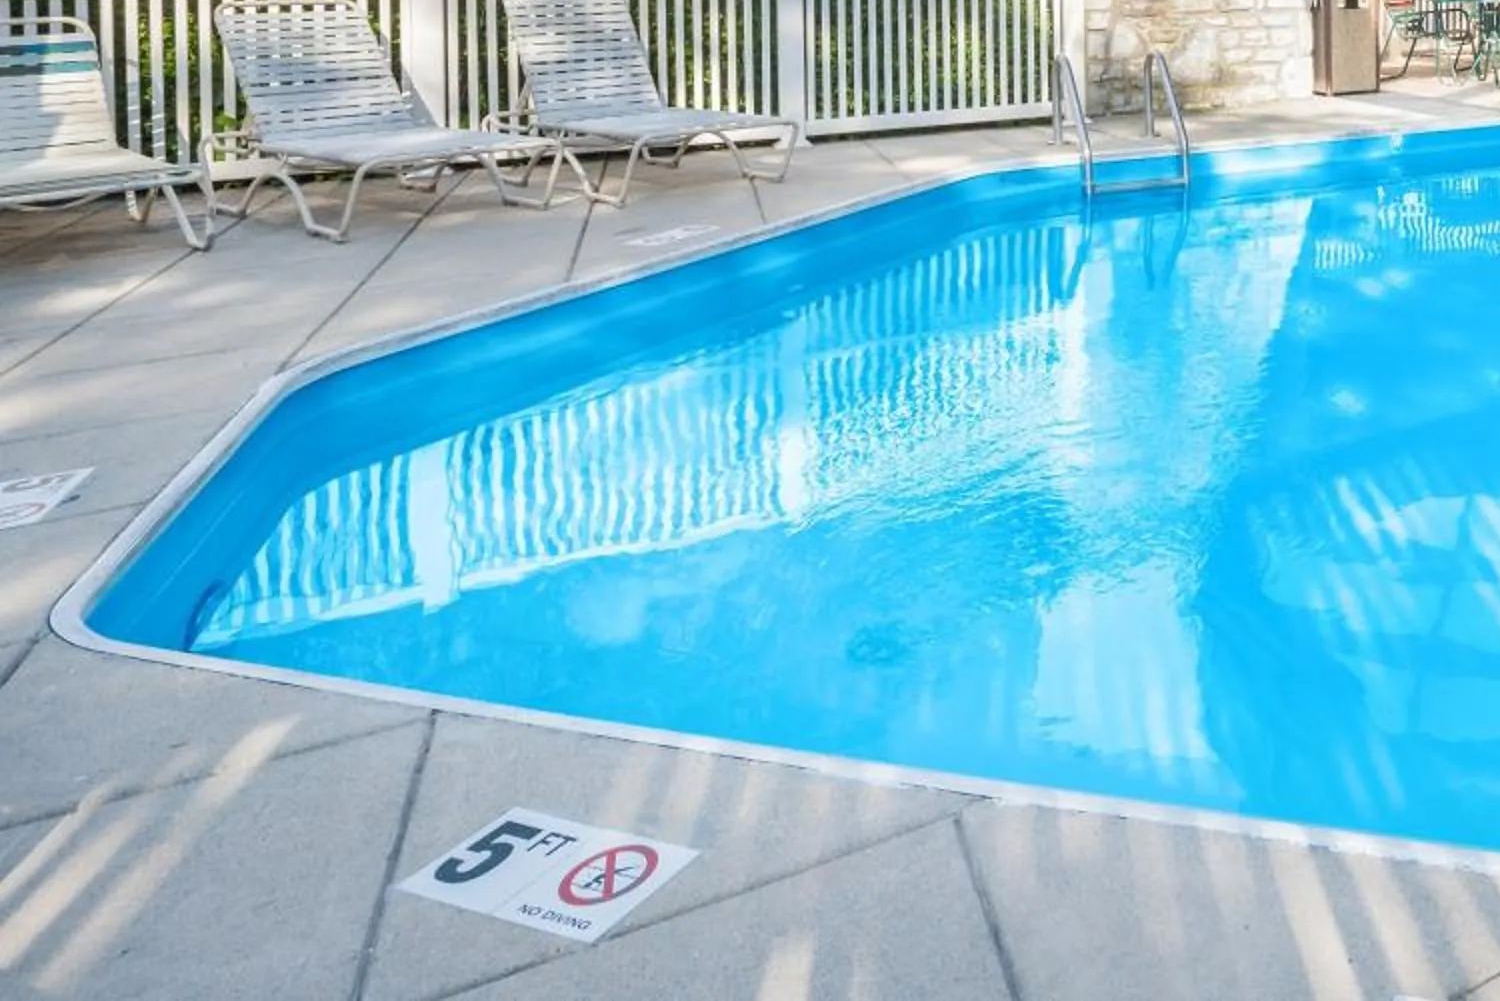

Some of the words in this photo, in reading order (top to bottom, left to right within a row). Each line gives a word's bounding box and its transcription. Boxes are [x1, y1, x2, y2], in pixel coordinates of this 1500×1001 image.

[433, 820, 544, 884] 5
[526, 831, 577, 857] FT
[518, 904, 542, 917] NO
